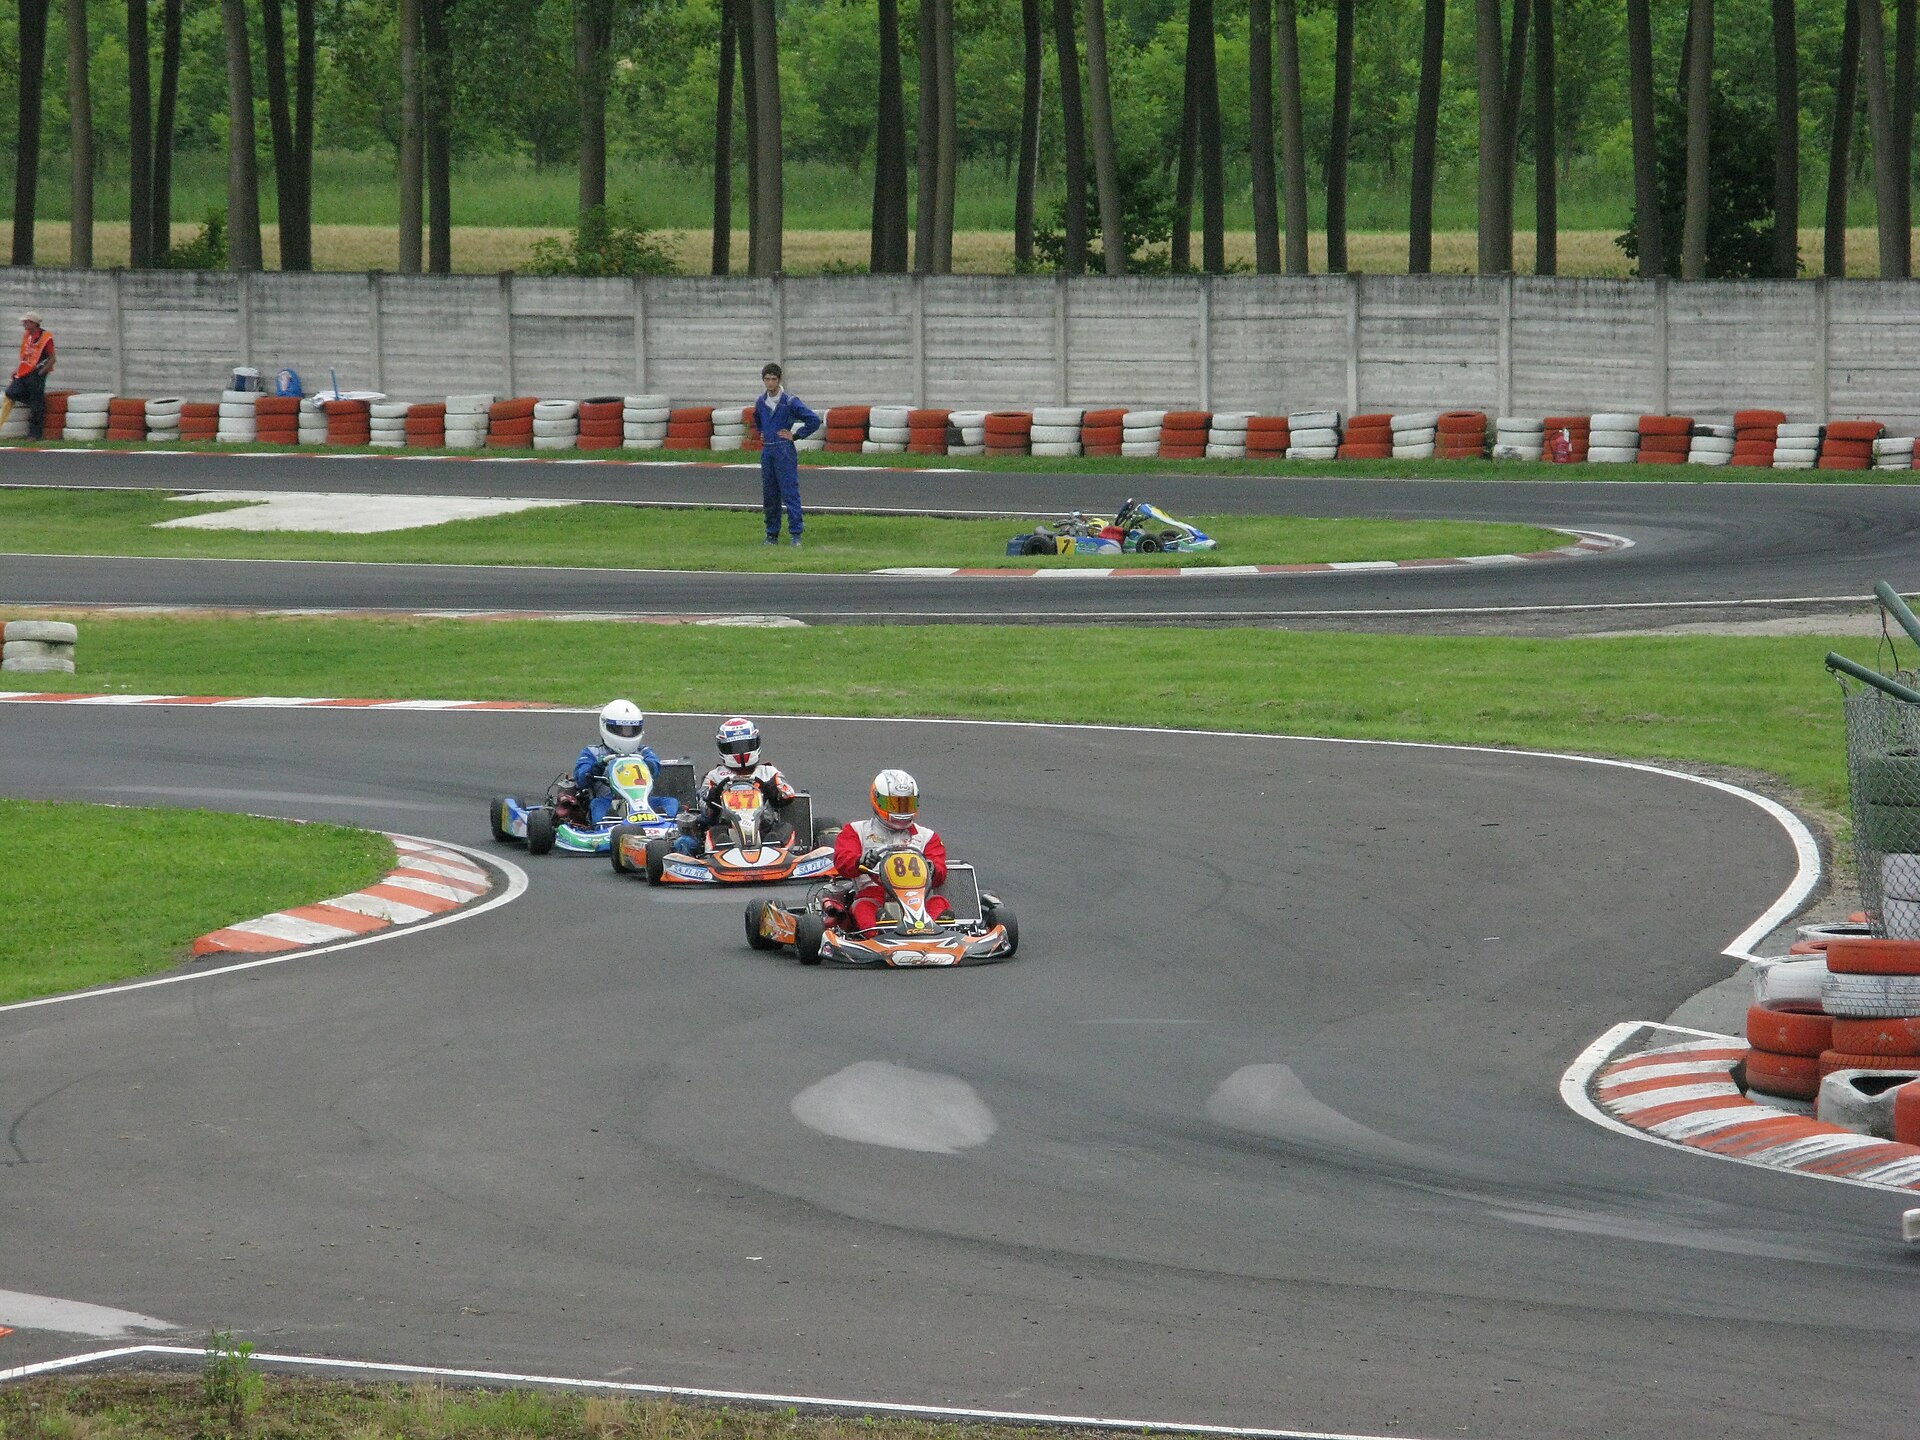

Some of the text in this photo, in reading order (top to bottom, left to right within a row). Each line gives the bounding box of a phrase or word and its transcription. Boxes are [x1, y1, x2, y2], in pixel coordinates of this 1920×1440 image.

[1061, 539, 1071, 554] 7
[631, 764, 647, 786] 1
[728, 792, 755, 810] 47
[893, 856, 921, 878] 84
